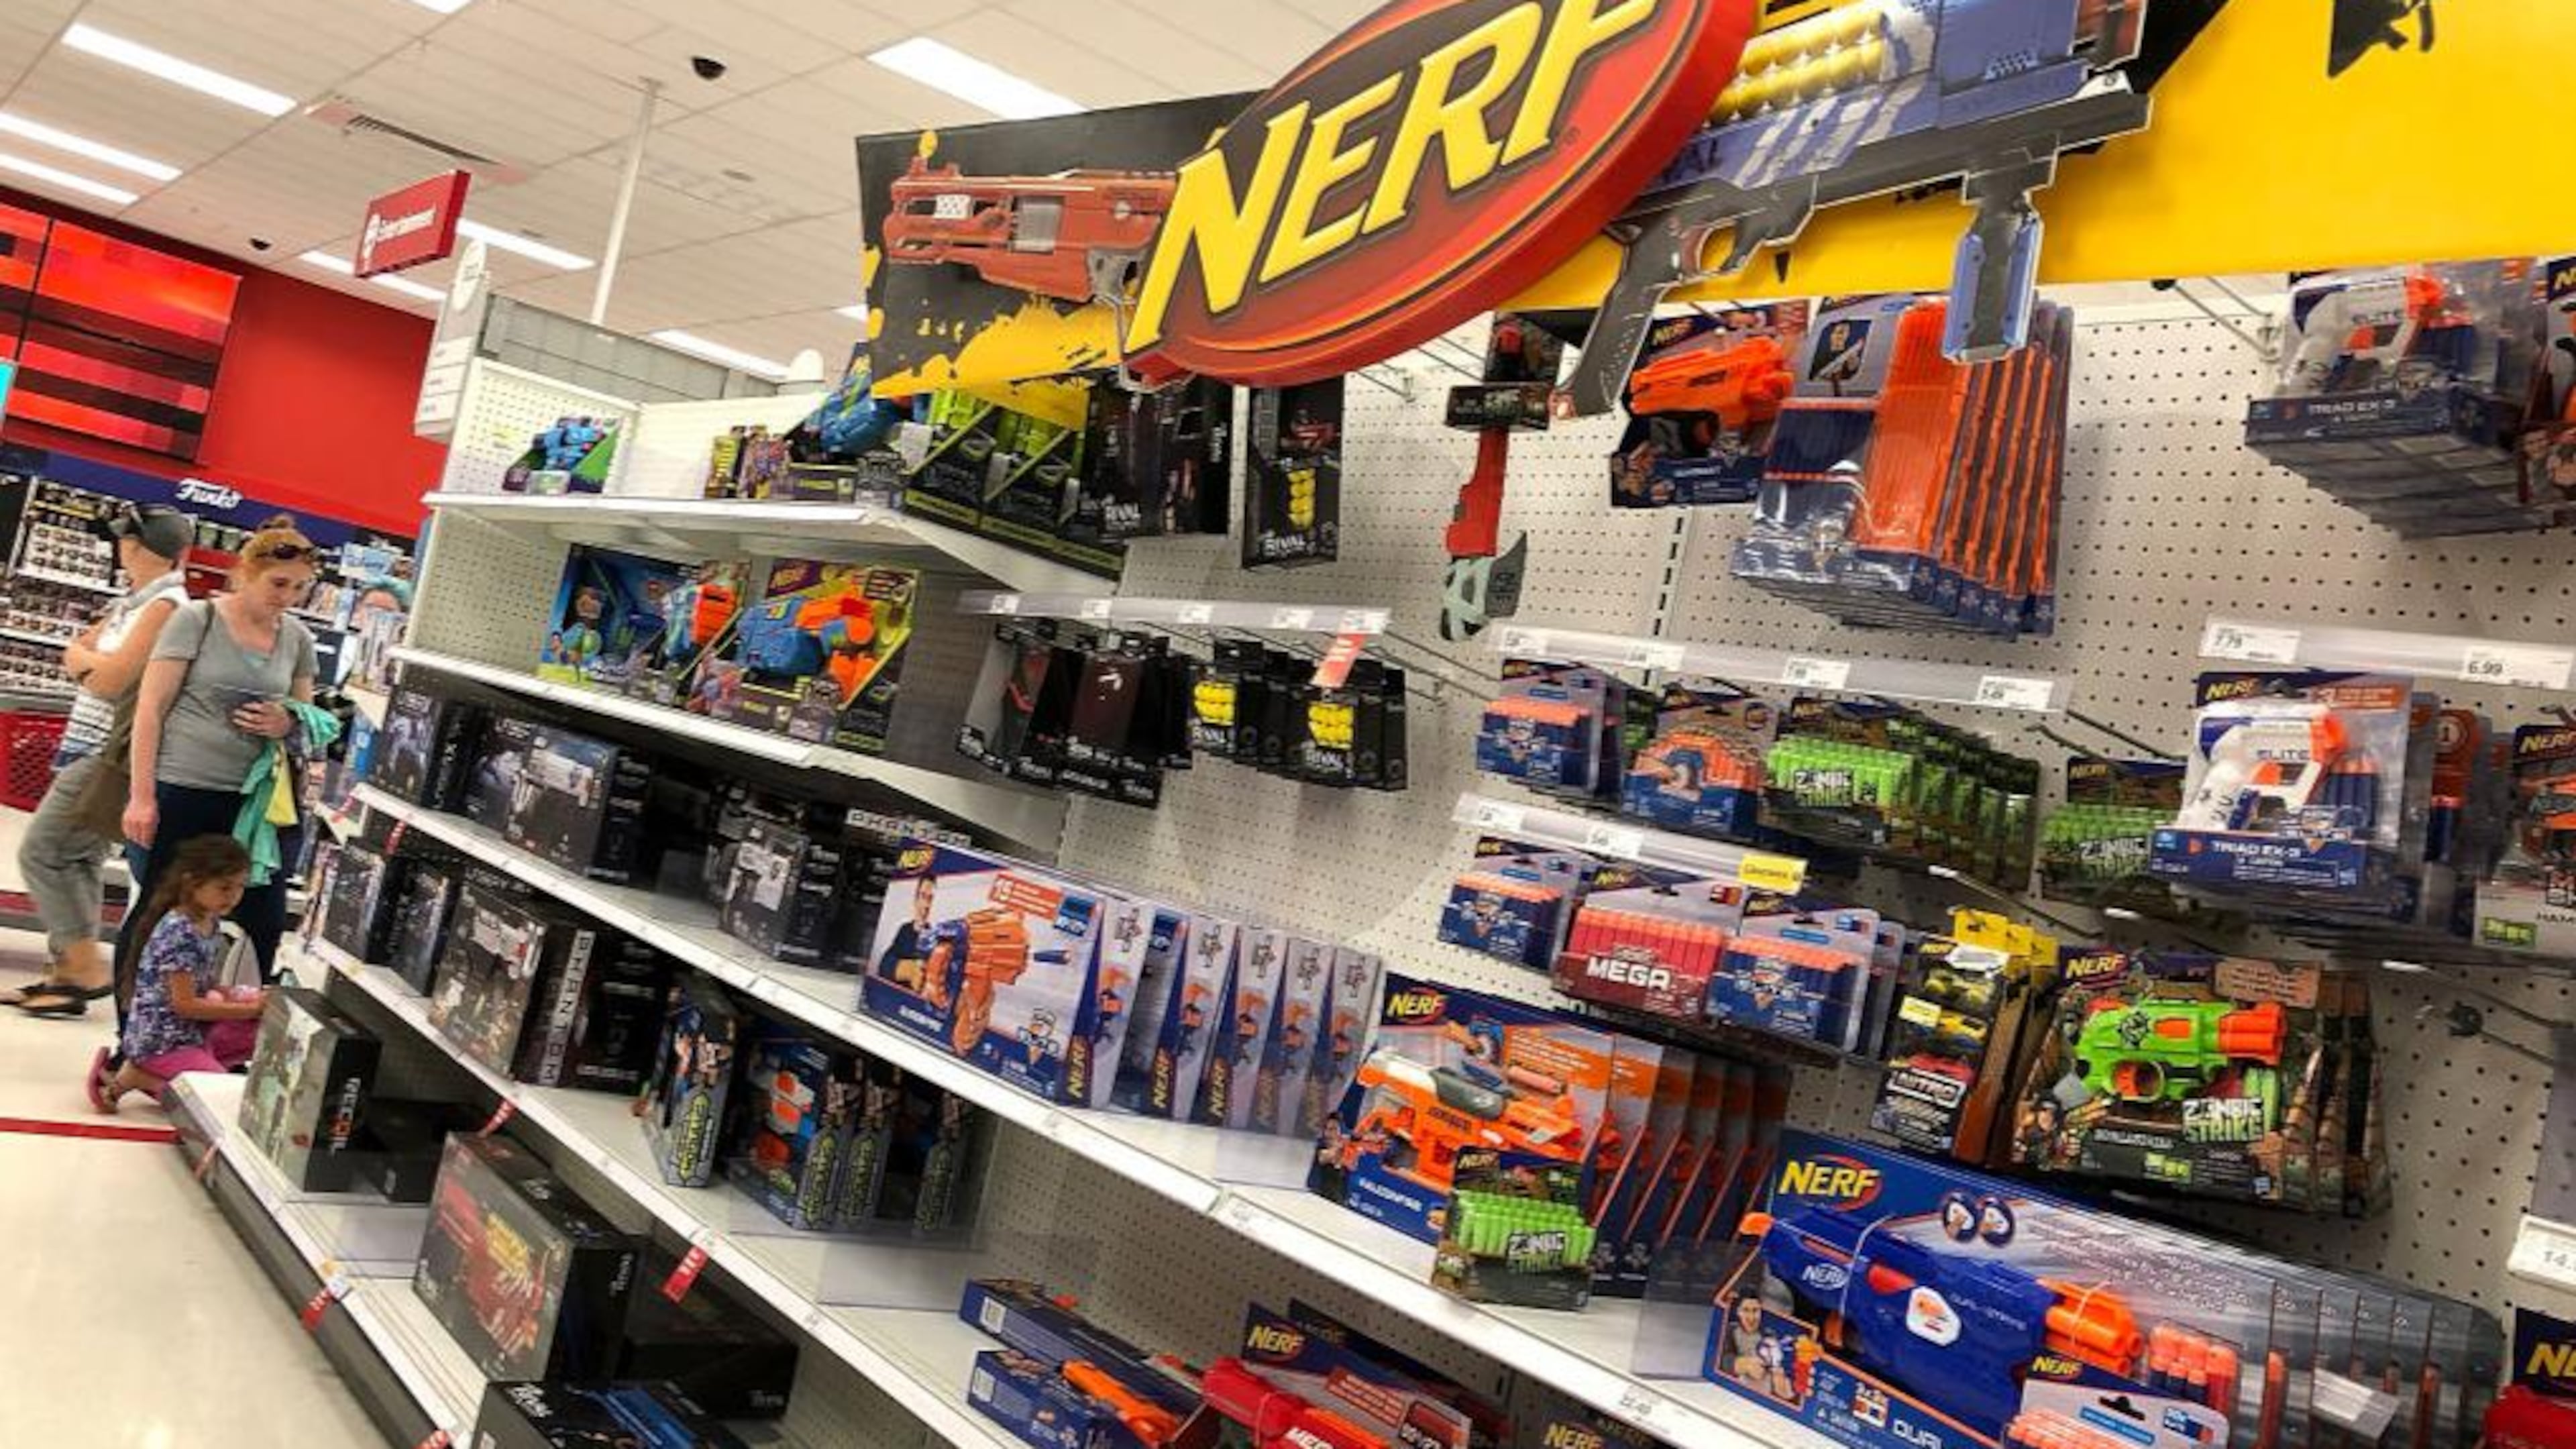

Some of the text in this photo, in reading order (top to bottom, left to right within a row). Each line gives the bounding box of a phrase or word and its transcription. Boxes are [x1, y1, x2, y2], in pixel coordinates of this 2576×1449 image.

[1126, 0, 1652, 353] NERF
[176, 478, 241, 509] Funko
[2469, 660, 2502, 676] 6.99
[2206, 678, 2259, 699] NERF
[2211, 840, 2302, 858] TRIAD EX-3
[1587, 956, 1672, 992] MEGA
[2065, 953, 2126, 979] NERF
[1387, 992, 1447, 1018] NERF
[1152, 1046, 1173, 1110] NERF
[1896, 1073, 1957, 1101] NITRO
[332, 1077, 362, 1150] RECOIL
[2182, 1097, 2263, 1119] ZOMBIE
[2185, 1118, 2265, 1142] STRIKE
[1457, 1152, 1499, 1170] NERF
[1779, 1161, 1880, 1197] NERF
[1248, 1325, 1307, 1355] NERF
[2031, 1355, 2082, 1379] NERF
[1544, 1421, 1604, 1449] NERF
